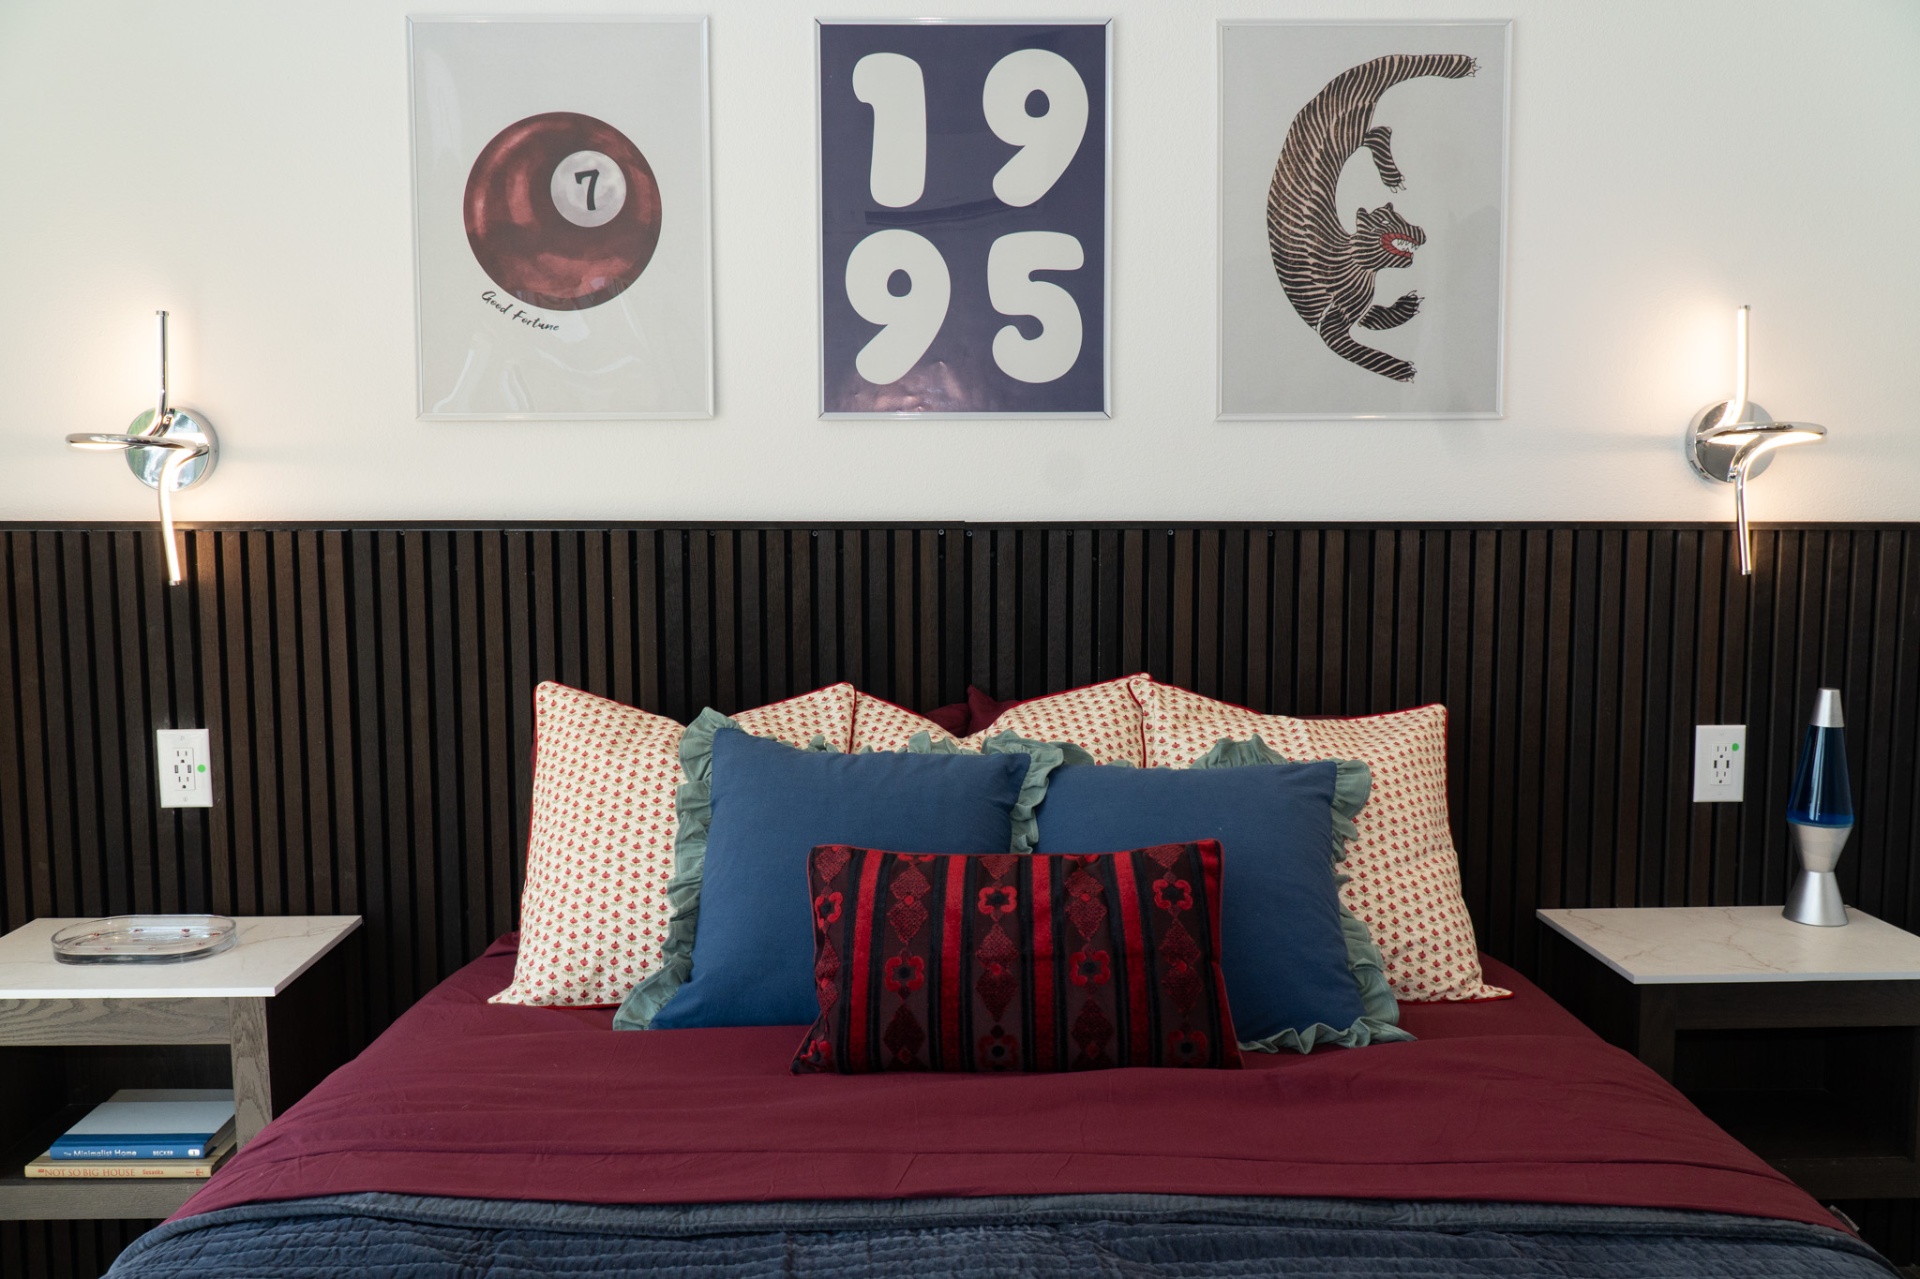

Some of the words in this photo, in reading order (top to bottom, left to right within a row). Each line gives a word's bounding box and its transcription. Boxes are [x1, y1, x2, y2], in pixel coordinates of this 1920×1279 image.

[574, 169, 600, 211] 7
[481, 290, 514, 315] Good
[511, 310, 560, 331] Fortune
[73, 1149, 112, 1157] Minimalist
[114, 1149, 137, 1157] Home
[44, 1168, 65, 1177] NOT
[67, 1168, 81, 1177] SO
[82, 1168, 99, 1177] BIG
[102, 1168, 136, 1177] HOUSE
